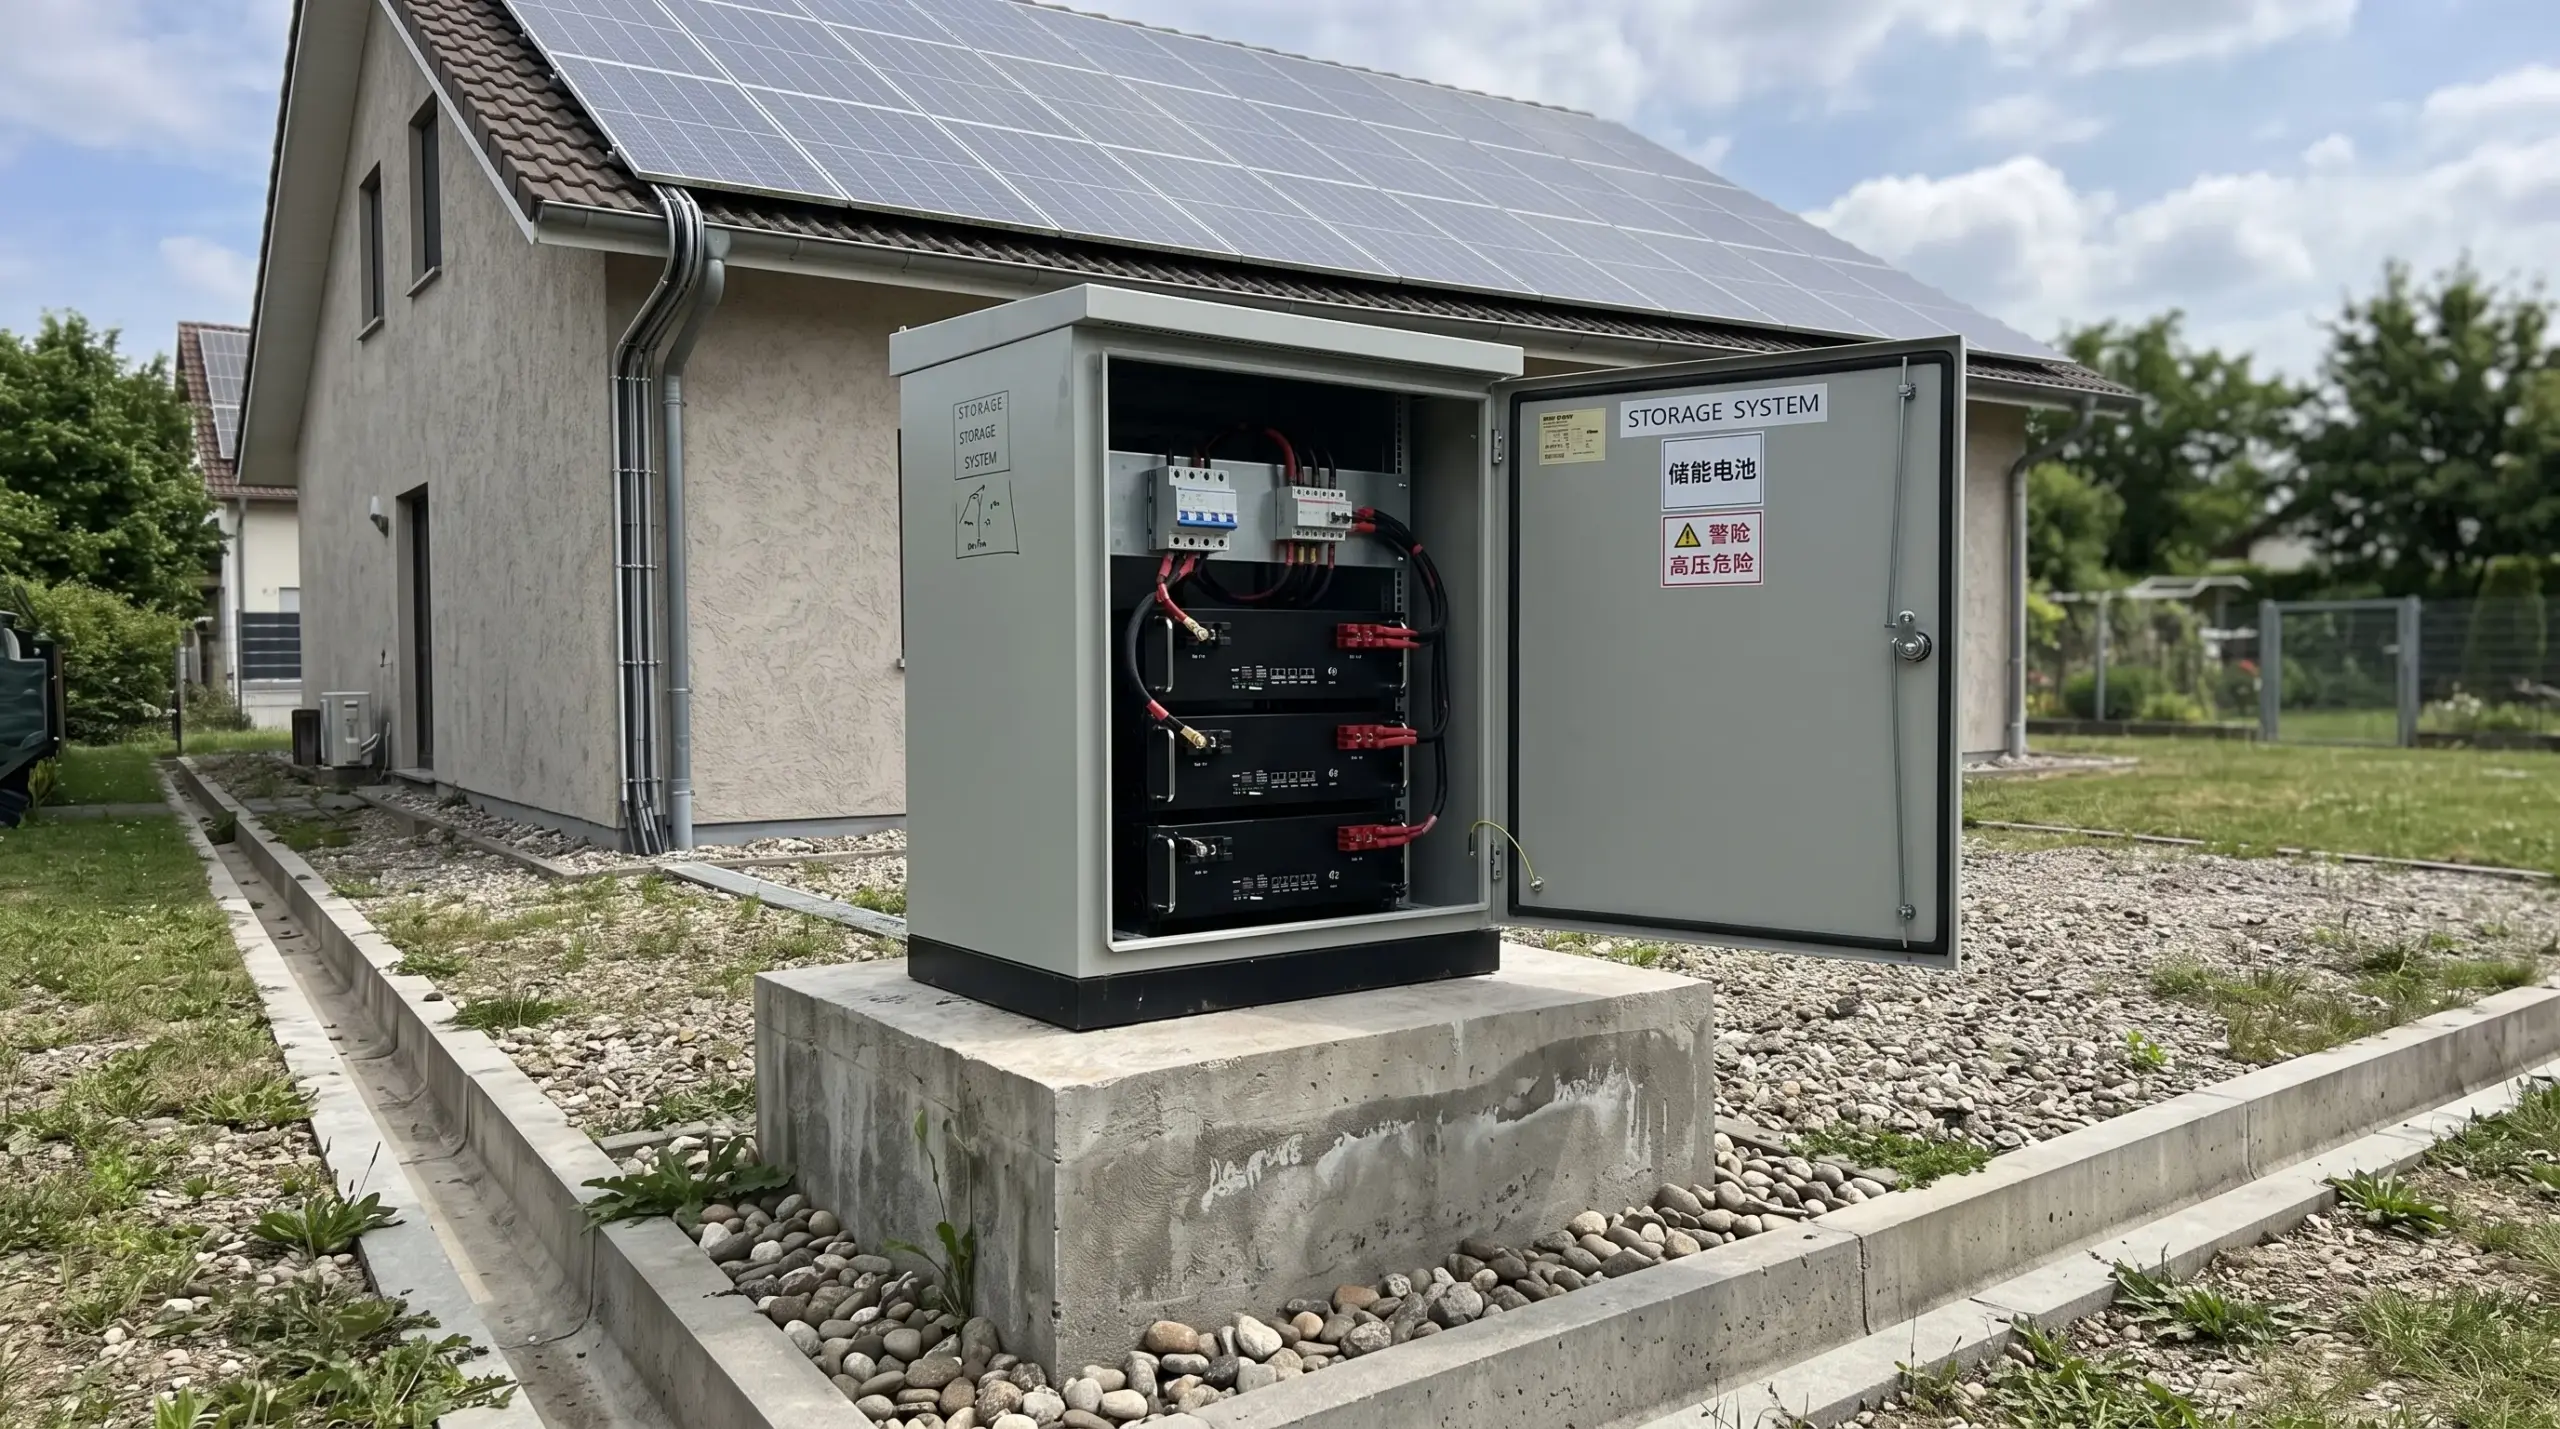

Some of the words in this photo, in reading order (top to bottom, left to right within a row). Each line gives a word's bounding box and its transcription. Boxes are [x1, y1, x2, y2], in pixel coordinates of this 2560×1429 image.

[958, 396, 1003, 420] STORAGE
[1628, 402, 1723, 428] STORAGE
[1734, 393, 1820, 420] SYSTEM
[959, 424, 996, 445] STORAGE
[964, 450, 997, 470] SYSTEM
[1668, 457, 1757, 486] 储能电池
[1669, 551, 1754, 576] 高压危险
